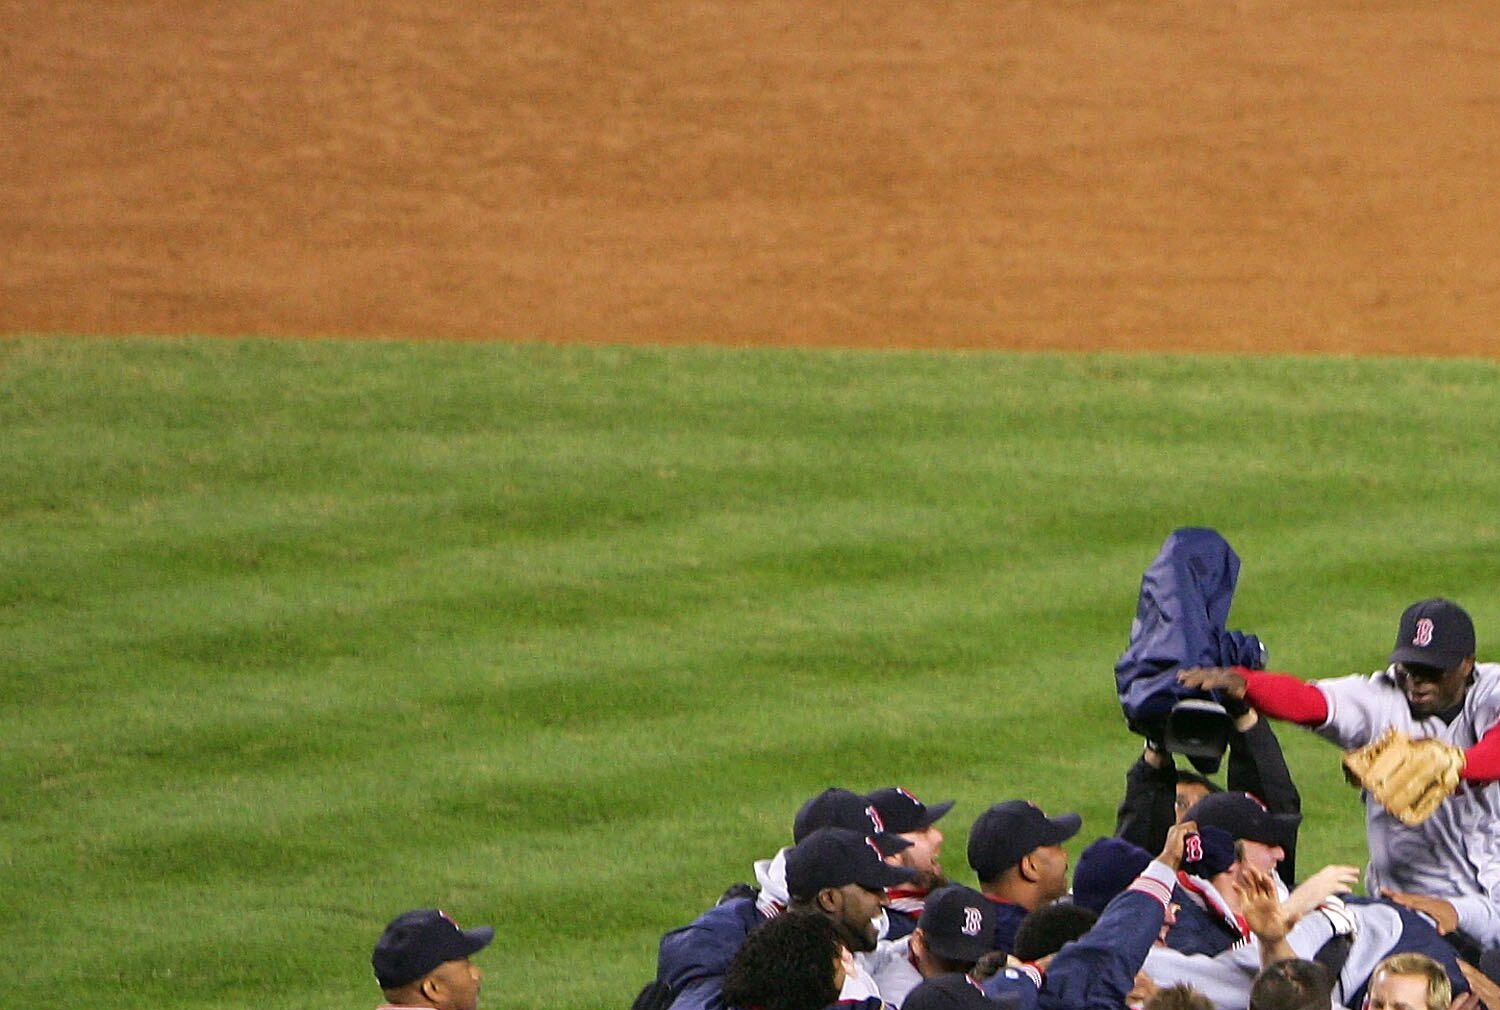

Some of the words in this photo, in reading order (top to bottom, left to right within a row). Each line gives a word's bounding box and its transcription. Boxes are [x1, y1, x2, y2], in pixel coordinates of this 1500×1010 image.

[1412, 617, 1434, 647] B
[1185, 834, 1204, 864] B
[961, 906, 983, 937] B
